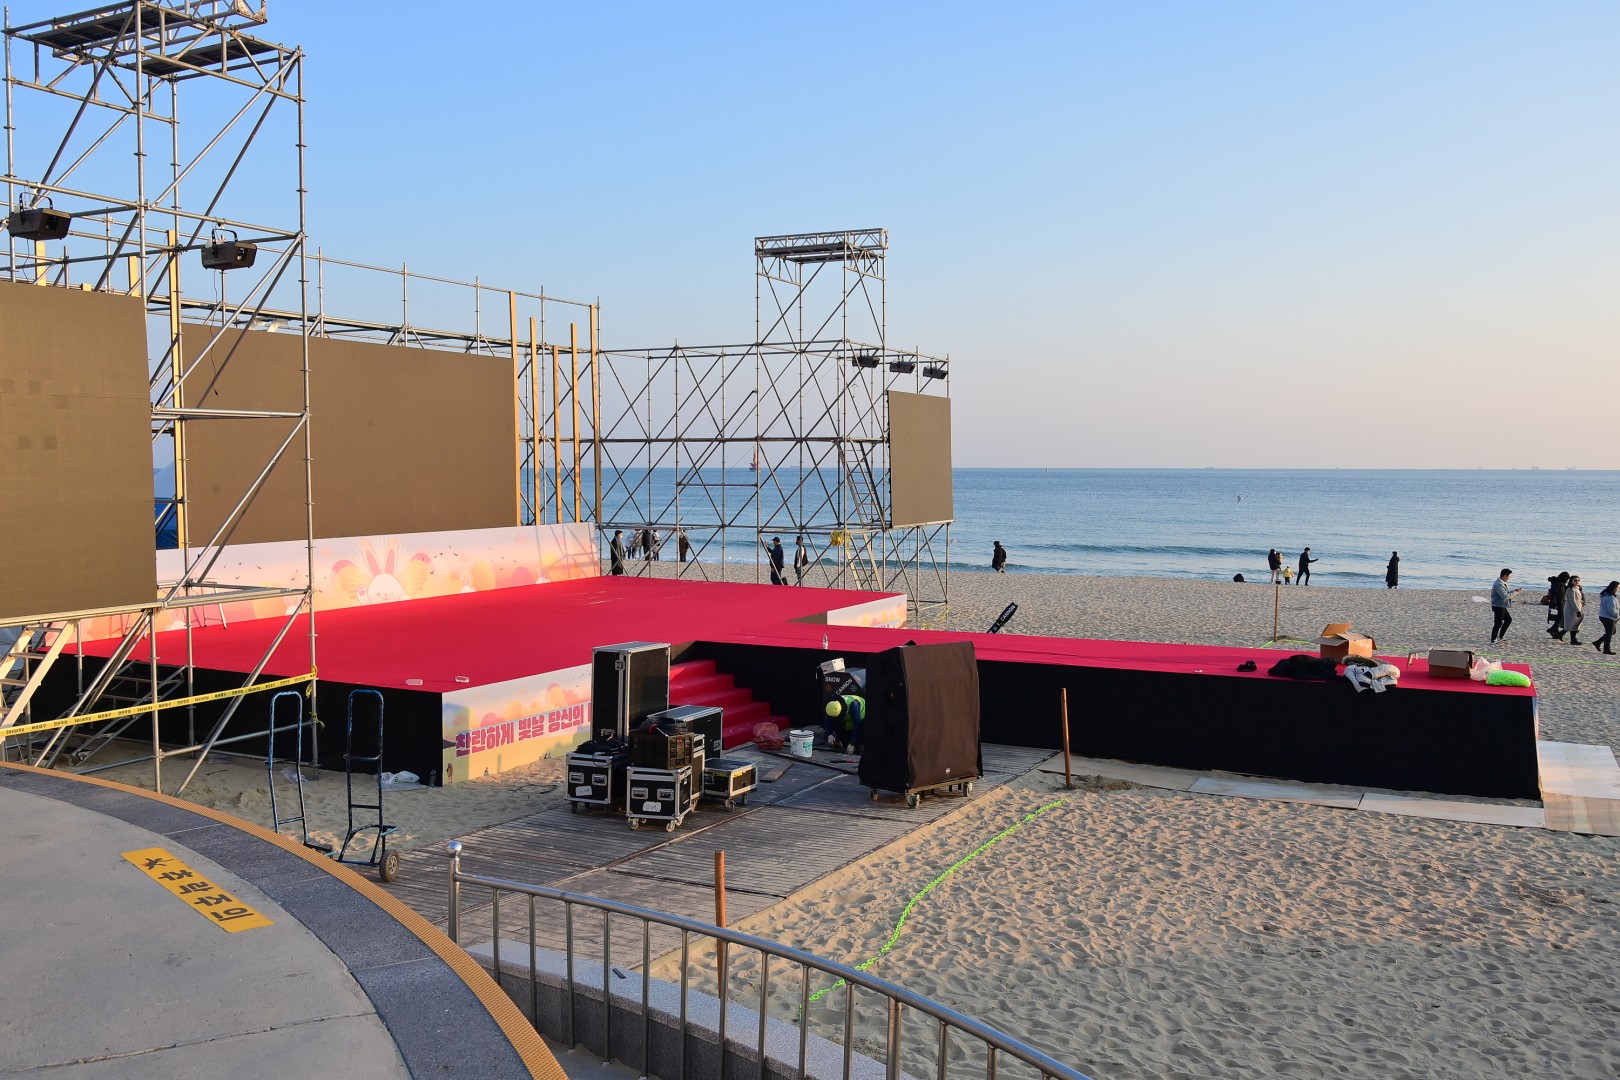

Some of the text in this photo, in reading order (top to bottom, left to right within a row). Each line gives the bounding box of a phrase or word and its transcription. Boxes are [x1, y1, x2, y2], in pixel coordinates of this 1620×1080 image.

[456, 721, 515, 758] 찬란하게
[519, 714, 545, 742] 빛날
[548, 704, 584, 733] 당신의
[158, 869, 254, 921] 추락주의
